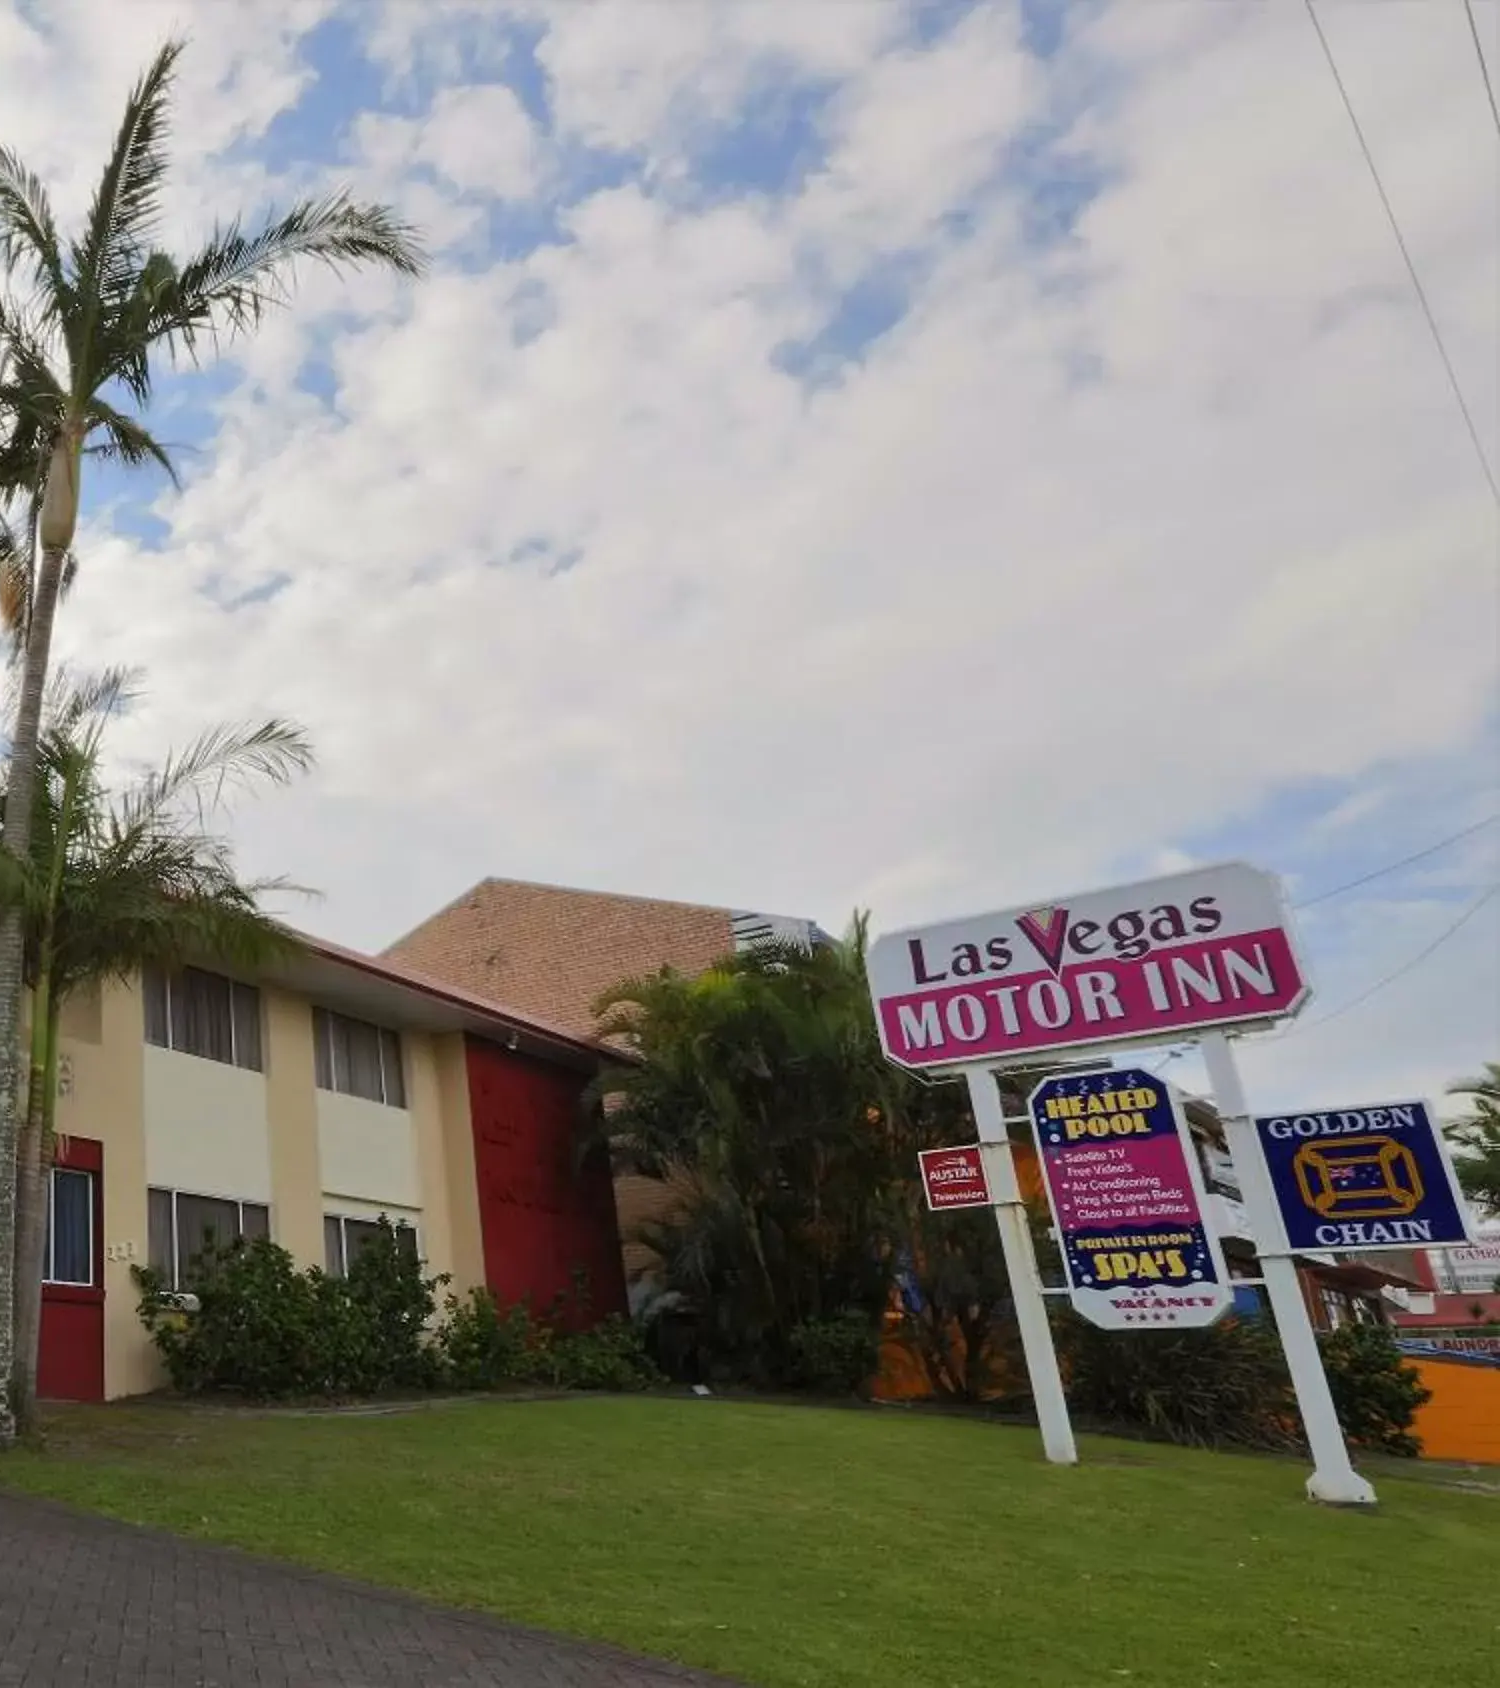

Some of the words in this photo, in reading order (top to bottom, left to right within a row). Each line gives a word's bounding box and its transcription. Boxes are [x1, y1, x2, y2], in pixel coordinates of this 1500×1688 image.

[908, 938, 1013, 985] Las
[1014, 896, 1222, 977] Vegas
[897, 970, 1125, 1051] MOTOR
[1143, 943, 1275, 1012] INN
[1046, 1088, 1157, 1119] HEATED
[1065, 1112, 1152, 1139] POOL
[1267, 1106, 1416, 1139] GOLDEN
[1108, 1148, 1125, 1159] TV
[929, 1167, 978, 1181] AUSTAR
[1067, 1167, 1092, 1177] Free
[1072, 1181, 1088, 1191] Air
[1090, 1176, 1161, 1190] Conditioning
[932, 1190, 985, 1201] Television
[1073, 1195, 1100, 1207] King
[1102, 1194, 1111, 1204] &
[1113, 1192, 1150, 1203] Queen
[1151, 1188, 1183, 1200] Beds
[1077, 1208, 1109, 1219] Close
[1111, 1207, 1123, 1217] to
[1125, 1206, 1138, 1217] all
[1315, 1219, 1433, 1245] CHAIN
[1093, 1249, 1187, 1281] SPA'S
[1109, 1296, 1215, 1309] VACANCY
